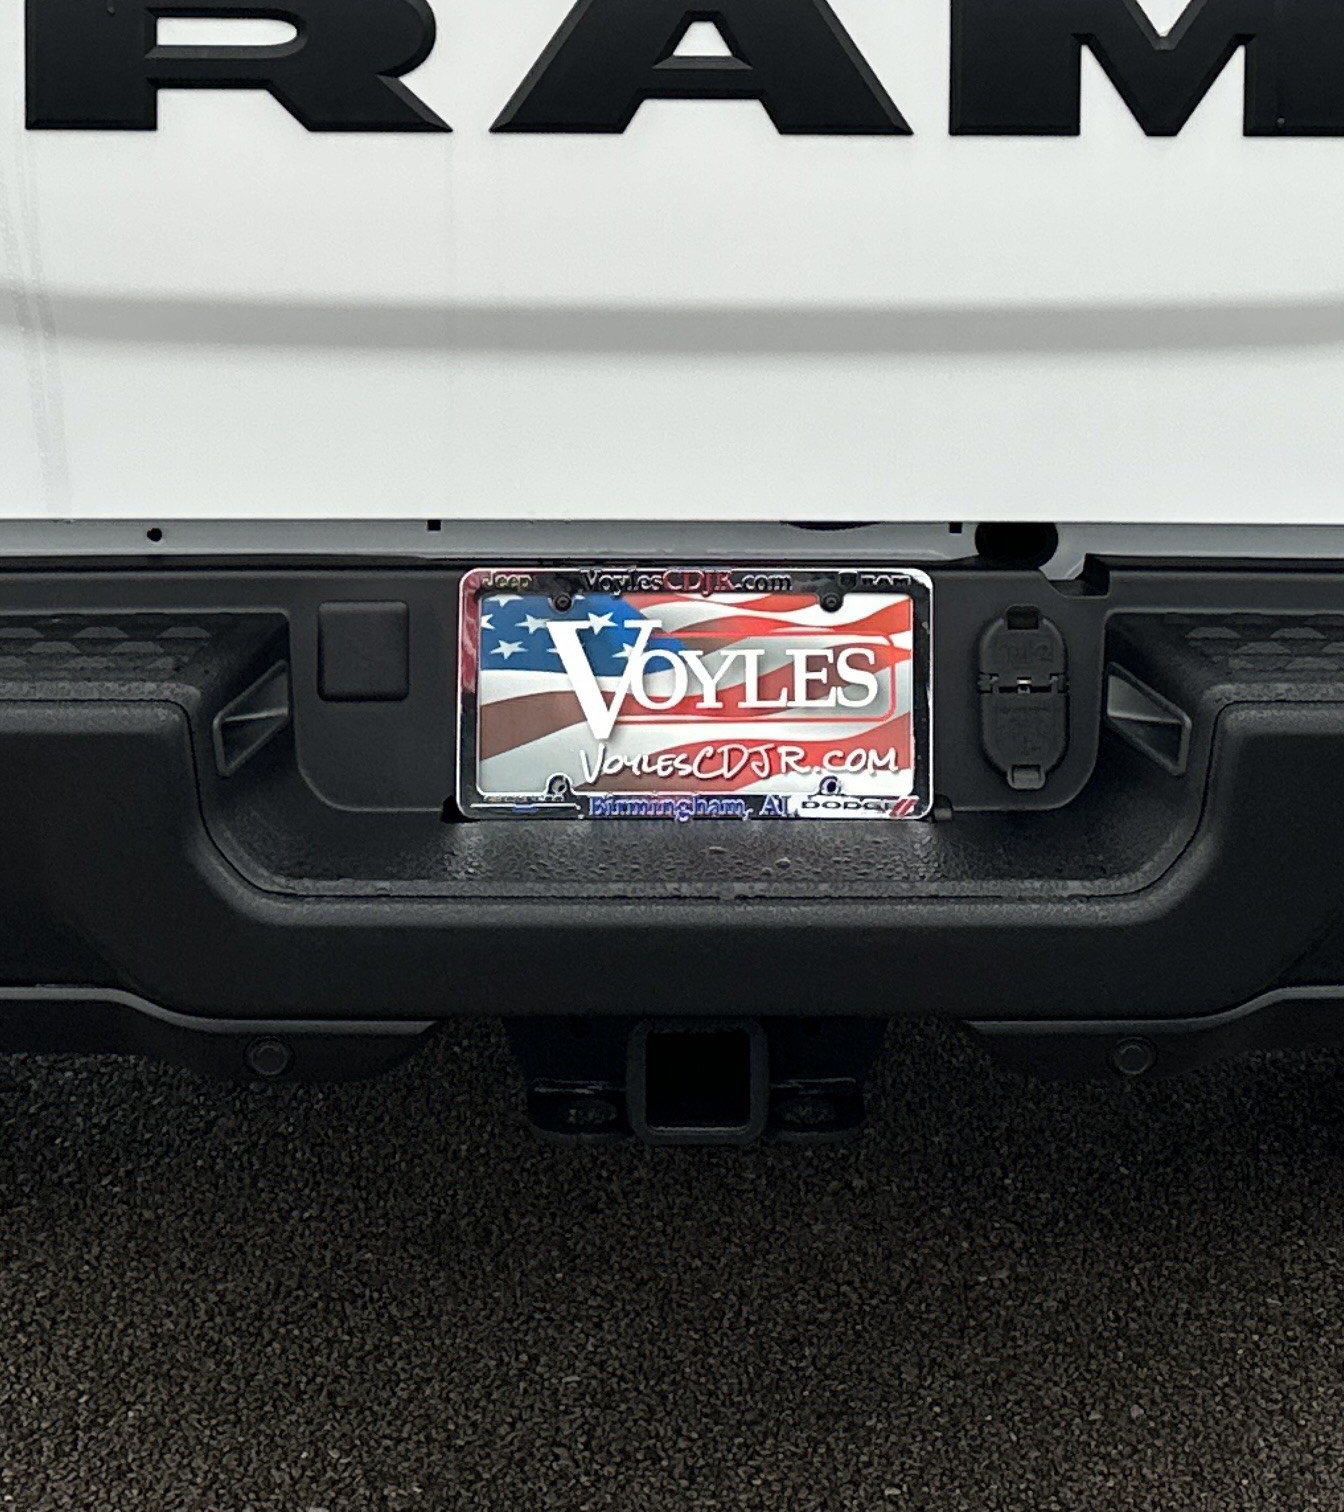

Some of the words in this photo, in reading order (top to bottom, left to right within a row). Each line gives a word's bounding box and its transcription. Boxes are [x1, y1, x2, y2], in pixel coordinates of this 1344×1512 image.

[580, 569, 792, 597] VoylesCDJR.com
[546, 620, 878, 740] VOYLES
[588, 794, 753, 821] Birmingham,
